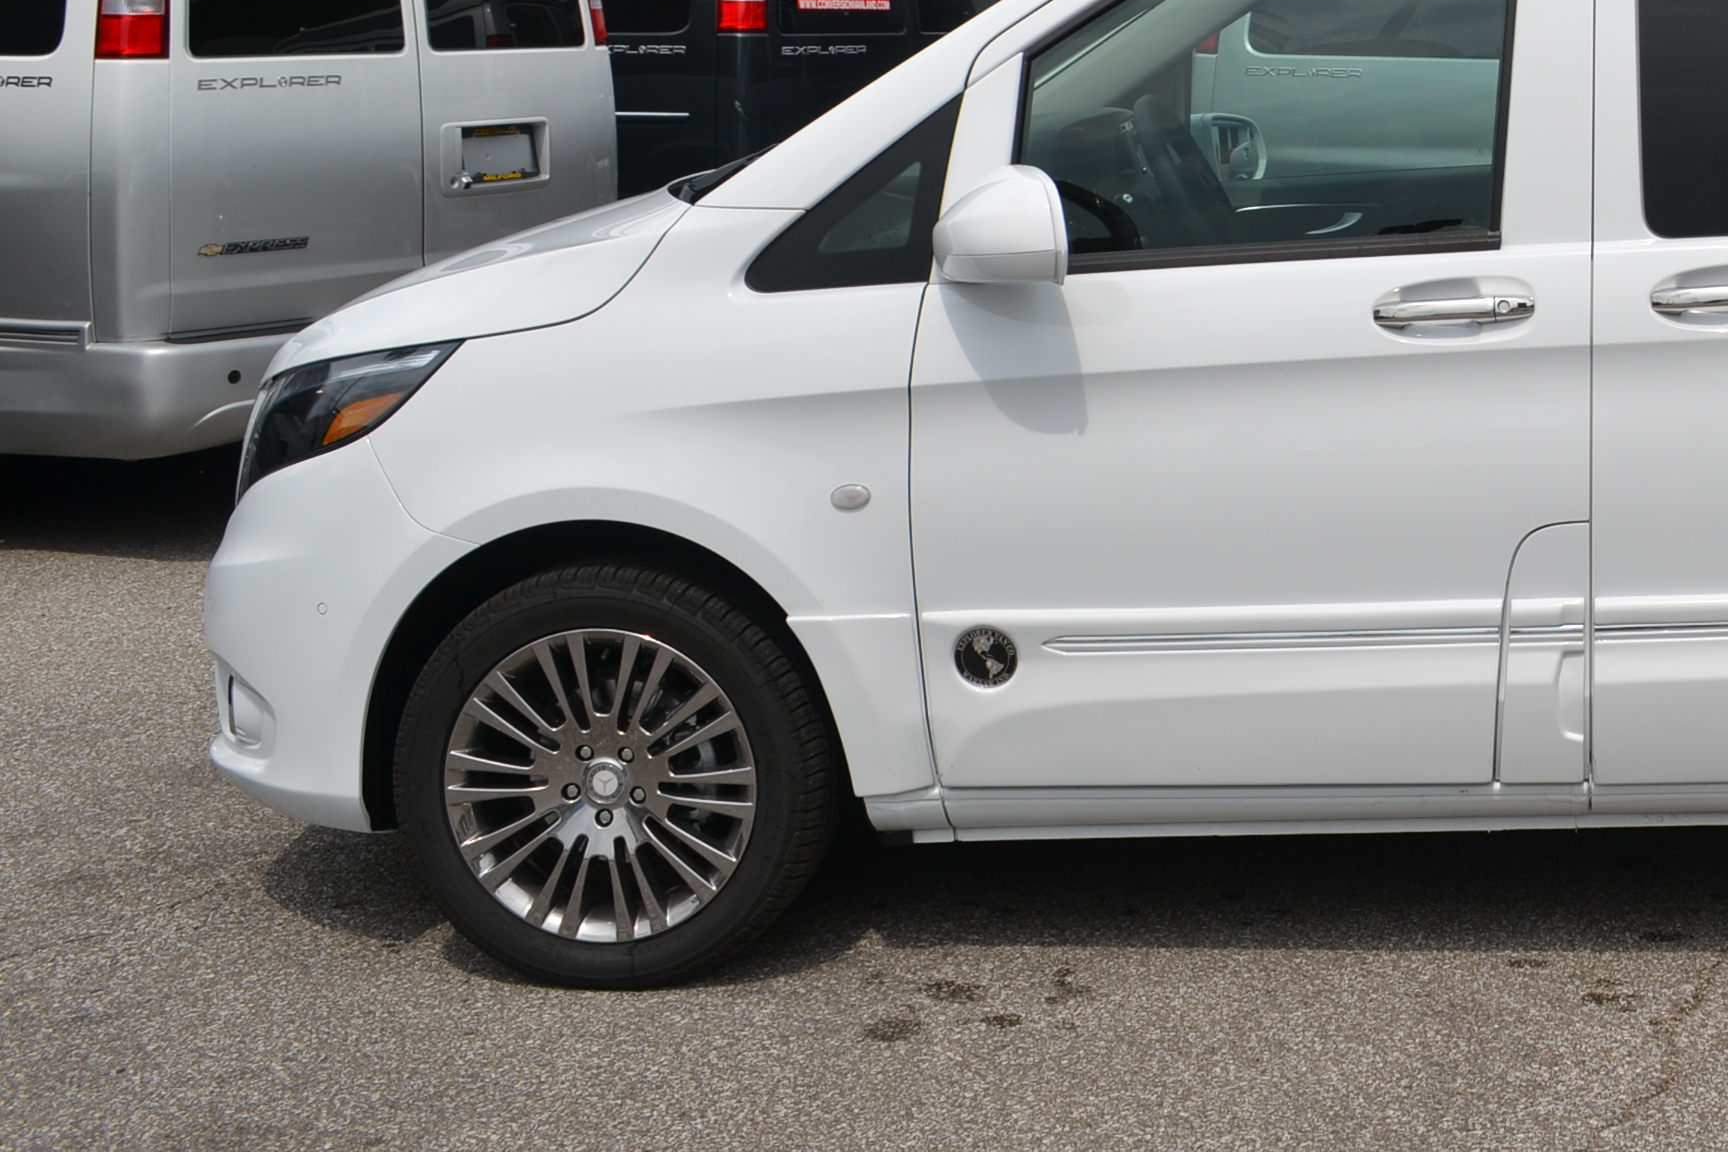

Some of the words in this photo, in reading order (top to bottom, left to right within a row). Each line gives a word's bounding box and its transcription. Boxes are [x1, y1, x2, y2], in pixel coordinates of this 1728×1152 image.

[781, 45, 866, 55] EXPLORER
[1245, 65, 1362, 78] EXPLORER
[197, 75, 341, 90] EXPLORER
[482, 171, 522, 181] MILFORD
[222, 236, 309, 255] EXPRESS
